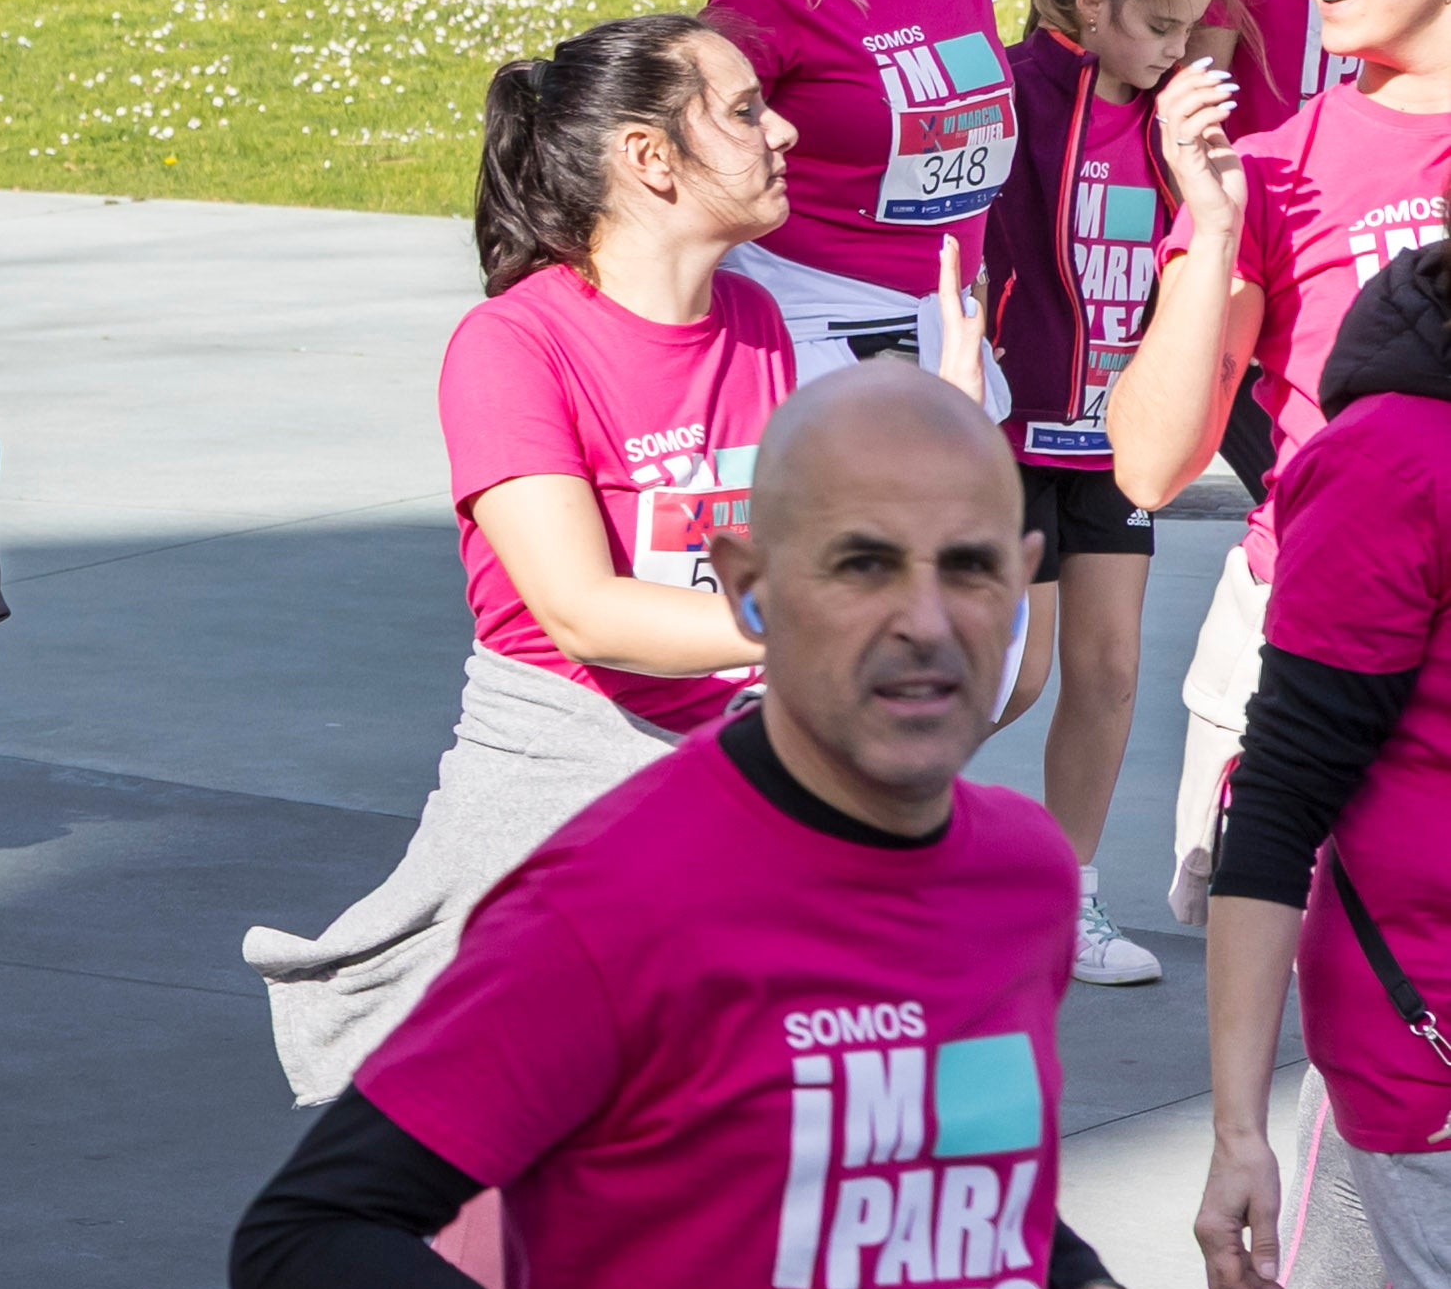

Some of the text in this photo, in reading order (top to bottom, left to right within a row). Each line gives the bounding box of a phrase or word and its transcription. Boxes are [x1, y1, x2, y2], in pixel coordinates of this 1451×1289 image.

[863, 25, 925, 53] SOMOS
[957, 104, 1003, 131] MARCHA
[922, 147, 989, 195] 348
[624, 423, 705, 463] SOMOS
[784, 1000, 926, 1049] SOMOS
